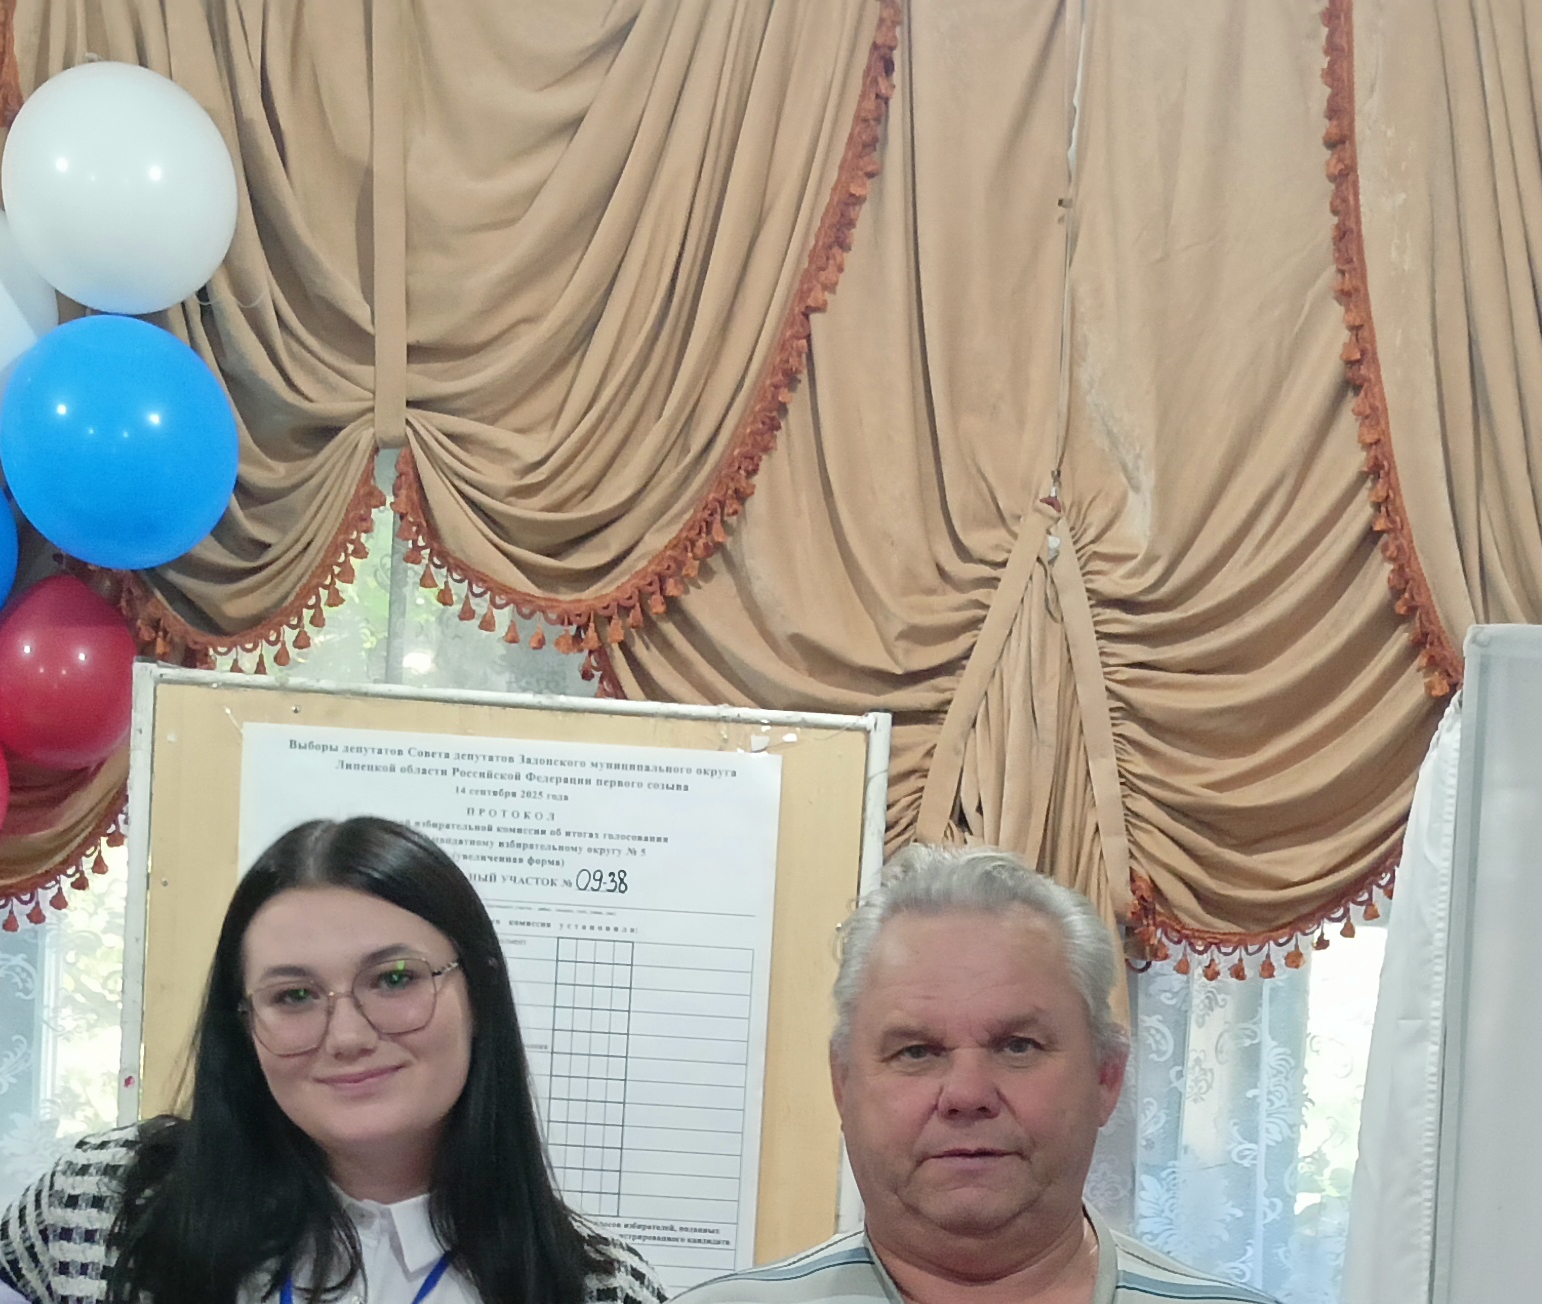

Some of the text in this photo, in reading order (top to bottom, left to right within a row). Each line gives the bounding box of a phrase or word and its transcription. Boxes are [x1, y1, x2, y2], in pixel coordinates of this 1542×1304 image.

[289, 740, 737, 779] Выборы депутатов Совета депутатов Задонского муниципального округа
[335, 760, 689, 793] Липецкой области Российской Федерации первого созыва
[455, 786, 569, 802] 14 сентября 2025 года
[414, 819, 493, 833] избирательной
[496, 826, 547, 837] комиссии
[550, 827, 562, 837] об
[565, 831, 599, 840] итогах
[603, 832, 669, 844] голосования
[498, 839, 583, 855] избирательному
[587, 846, 623, 858] округу
[527, 856, 565, 868] форма)
[502, 874, 558, 888] УЧАСТОК
